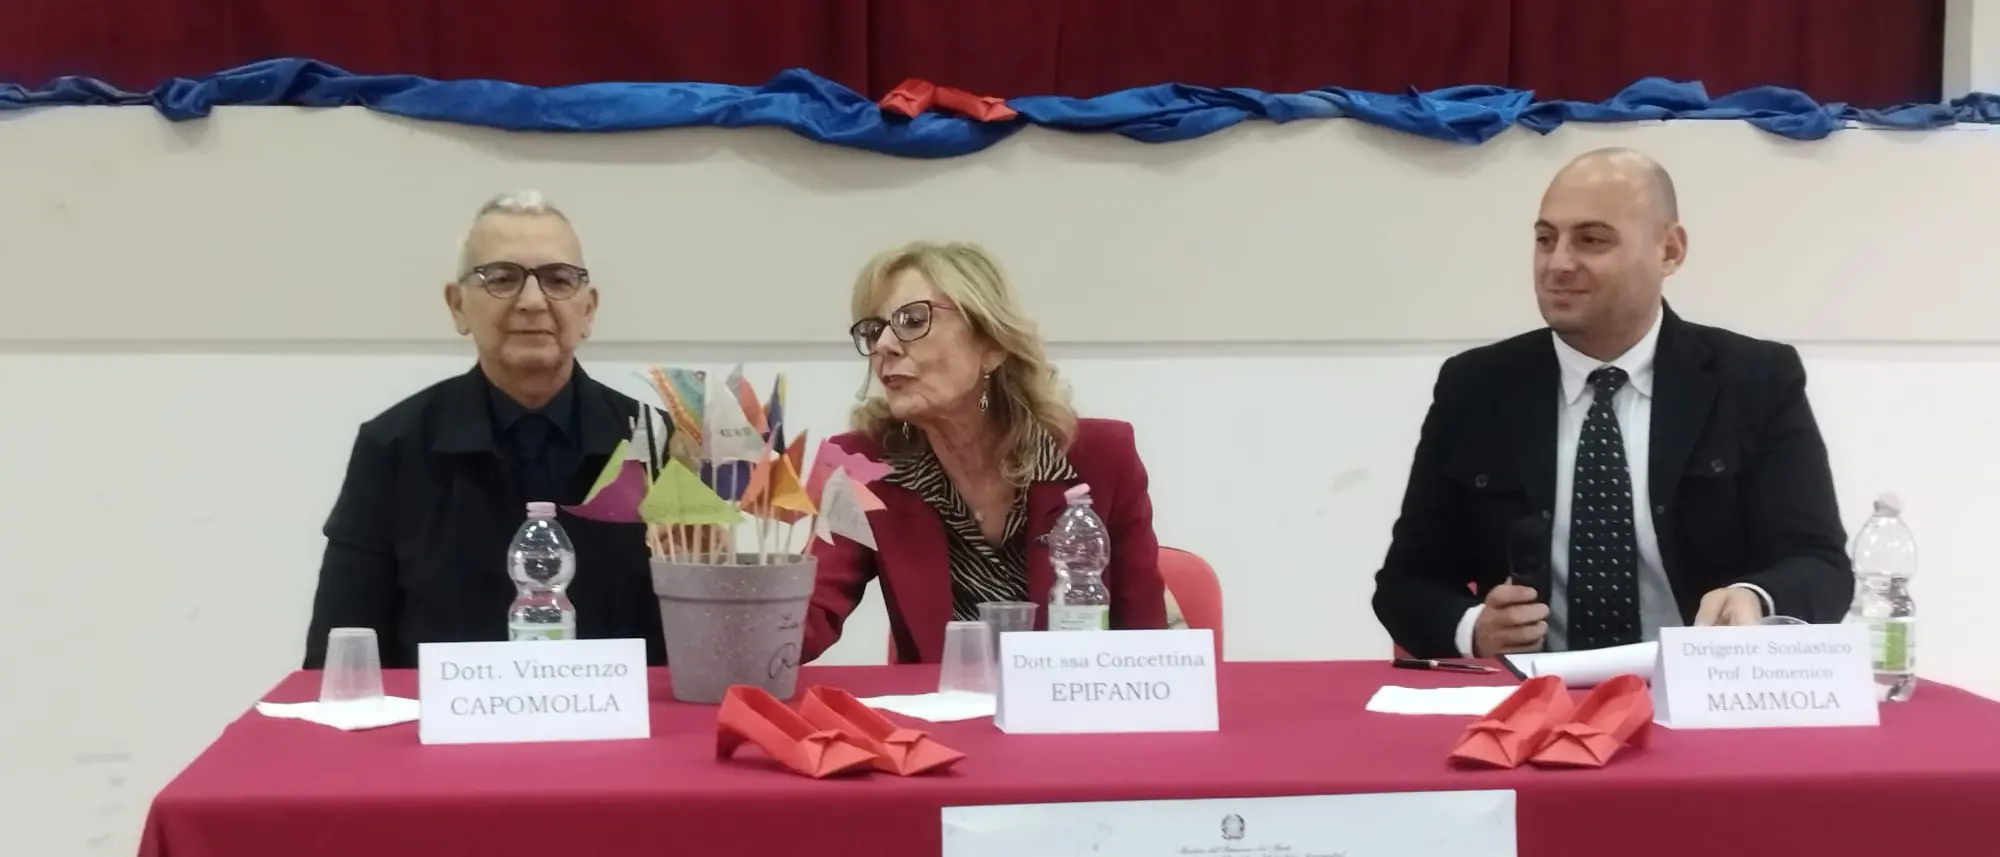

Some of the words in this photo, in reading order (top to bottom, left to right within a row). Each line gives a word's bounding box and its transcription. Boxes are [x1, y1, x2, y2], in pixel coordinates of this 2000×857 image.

[1096, 651, 1205, 669] Concettina
[1682, 642, 1760, 659] Dirigente
[1767, 640, 1852, 656] Scolastico
[441, 661, 502, 681] Dott.
[513, 660, 628, 680] Vincenzo
[1752, 664, 1833, 681] Domenico
[1052, 680, 1171, 703] EPIFANIO
[1706, 691, 1841, 712] MAMMOLA
[451, 693, 621, 716] CAPOMOLLA
